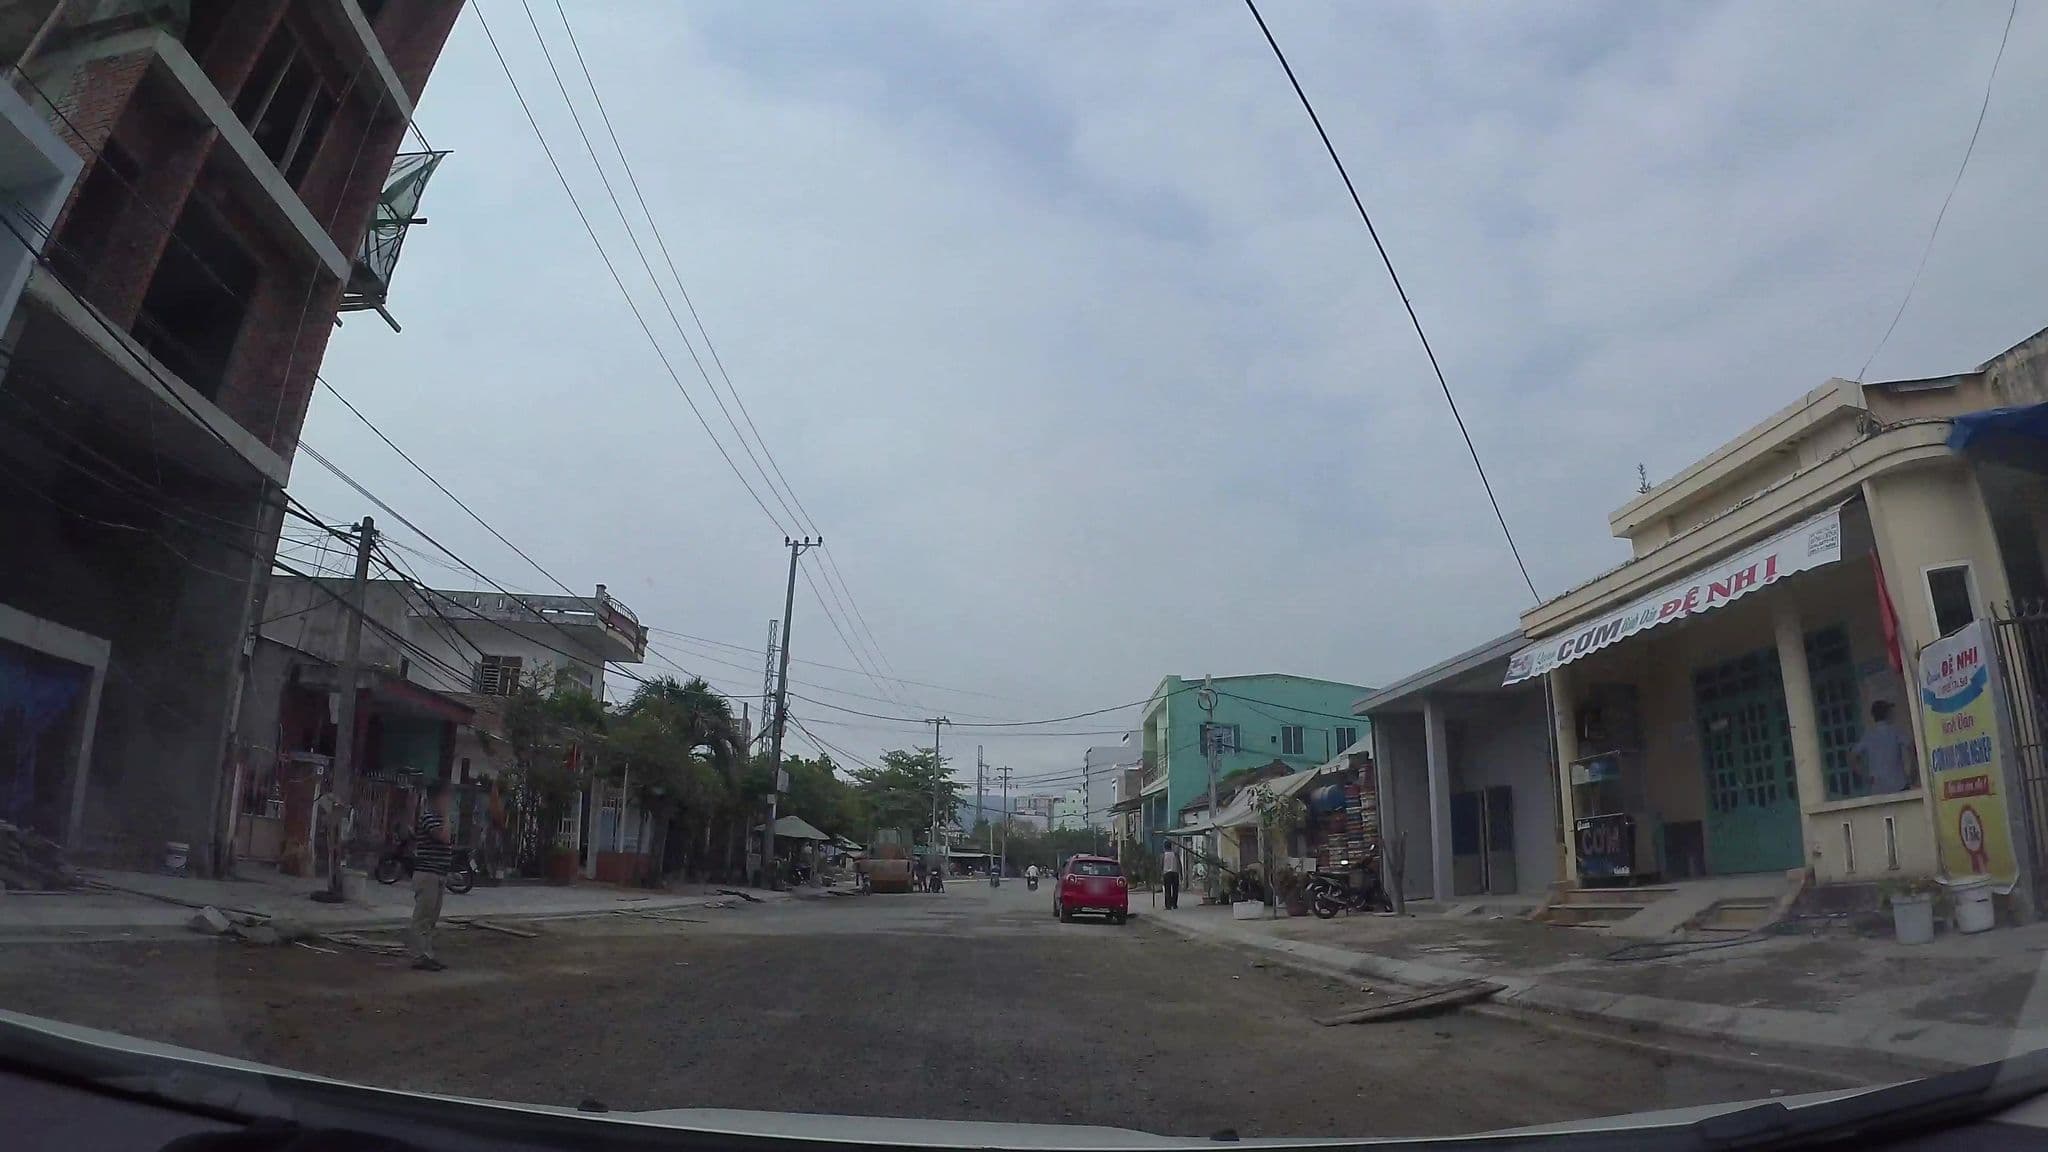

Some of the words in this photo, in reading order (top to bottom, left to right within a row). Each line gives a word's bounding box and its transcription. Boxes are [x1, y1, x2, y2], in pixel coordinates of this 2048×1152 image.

[1557, 618, 1623, 661] CƠM
[1657, 586, 1700, 620] ĐỆ
[1706, 554, 1778, 603] NHỊ
[1956, 646, 1978, 668] NHỊ
